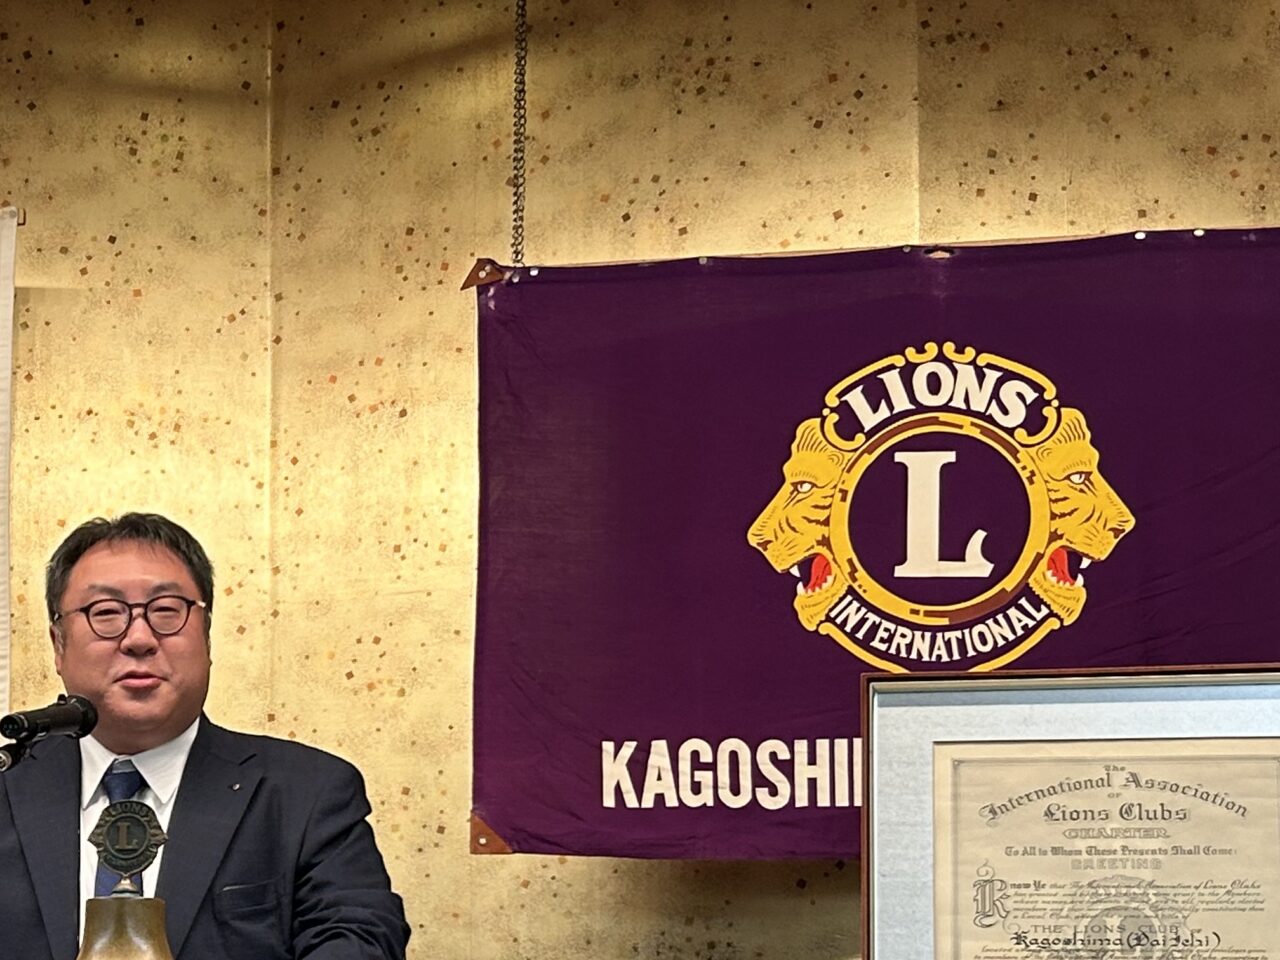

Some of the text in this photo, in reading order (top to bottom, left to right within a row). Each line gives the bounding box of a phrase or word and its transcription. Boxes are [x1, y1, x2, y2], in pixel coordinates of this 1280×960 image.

[840, 361, 1040, 433] LIONS
[893, 450, 995, 578] L
[828, 595, 1051, 663] INTERNATIONAL
[110, 802, 148, 816] LIONS
[978, 771, 1249, 828] International Association
[1043, 802, 1190, 823] Lions Clubs
[114, 822, 138, 850] L
[1062, 827, 1172, 840] CHARTER
[1004, 846, 1019, 857] To
[1021, 846, 1036, 856] All
[1050, 846, 1082, 856] Whom
[1085, 845, 1117, 856] These
[1120, 844, 1168, 856] Presents
[1170, 844, 1200, 856] Shall
[1010, 929, 1124, 949] Kagoshima
[1031, 924, 1065, 934] THE
[1074, 924, 1125, 934] LIONS
